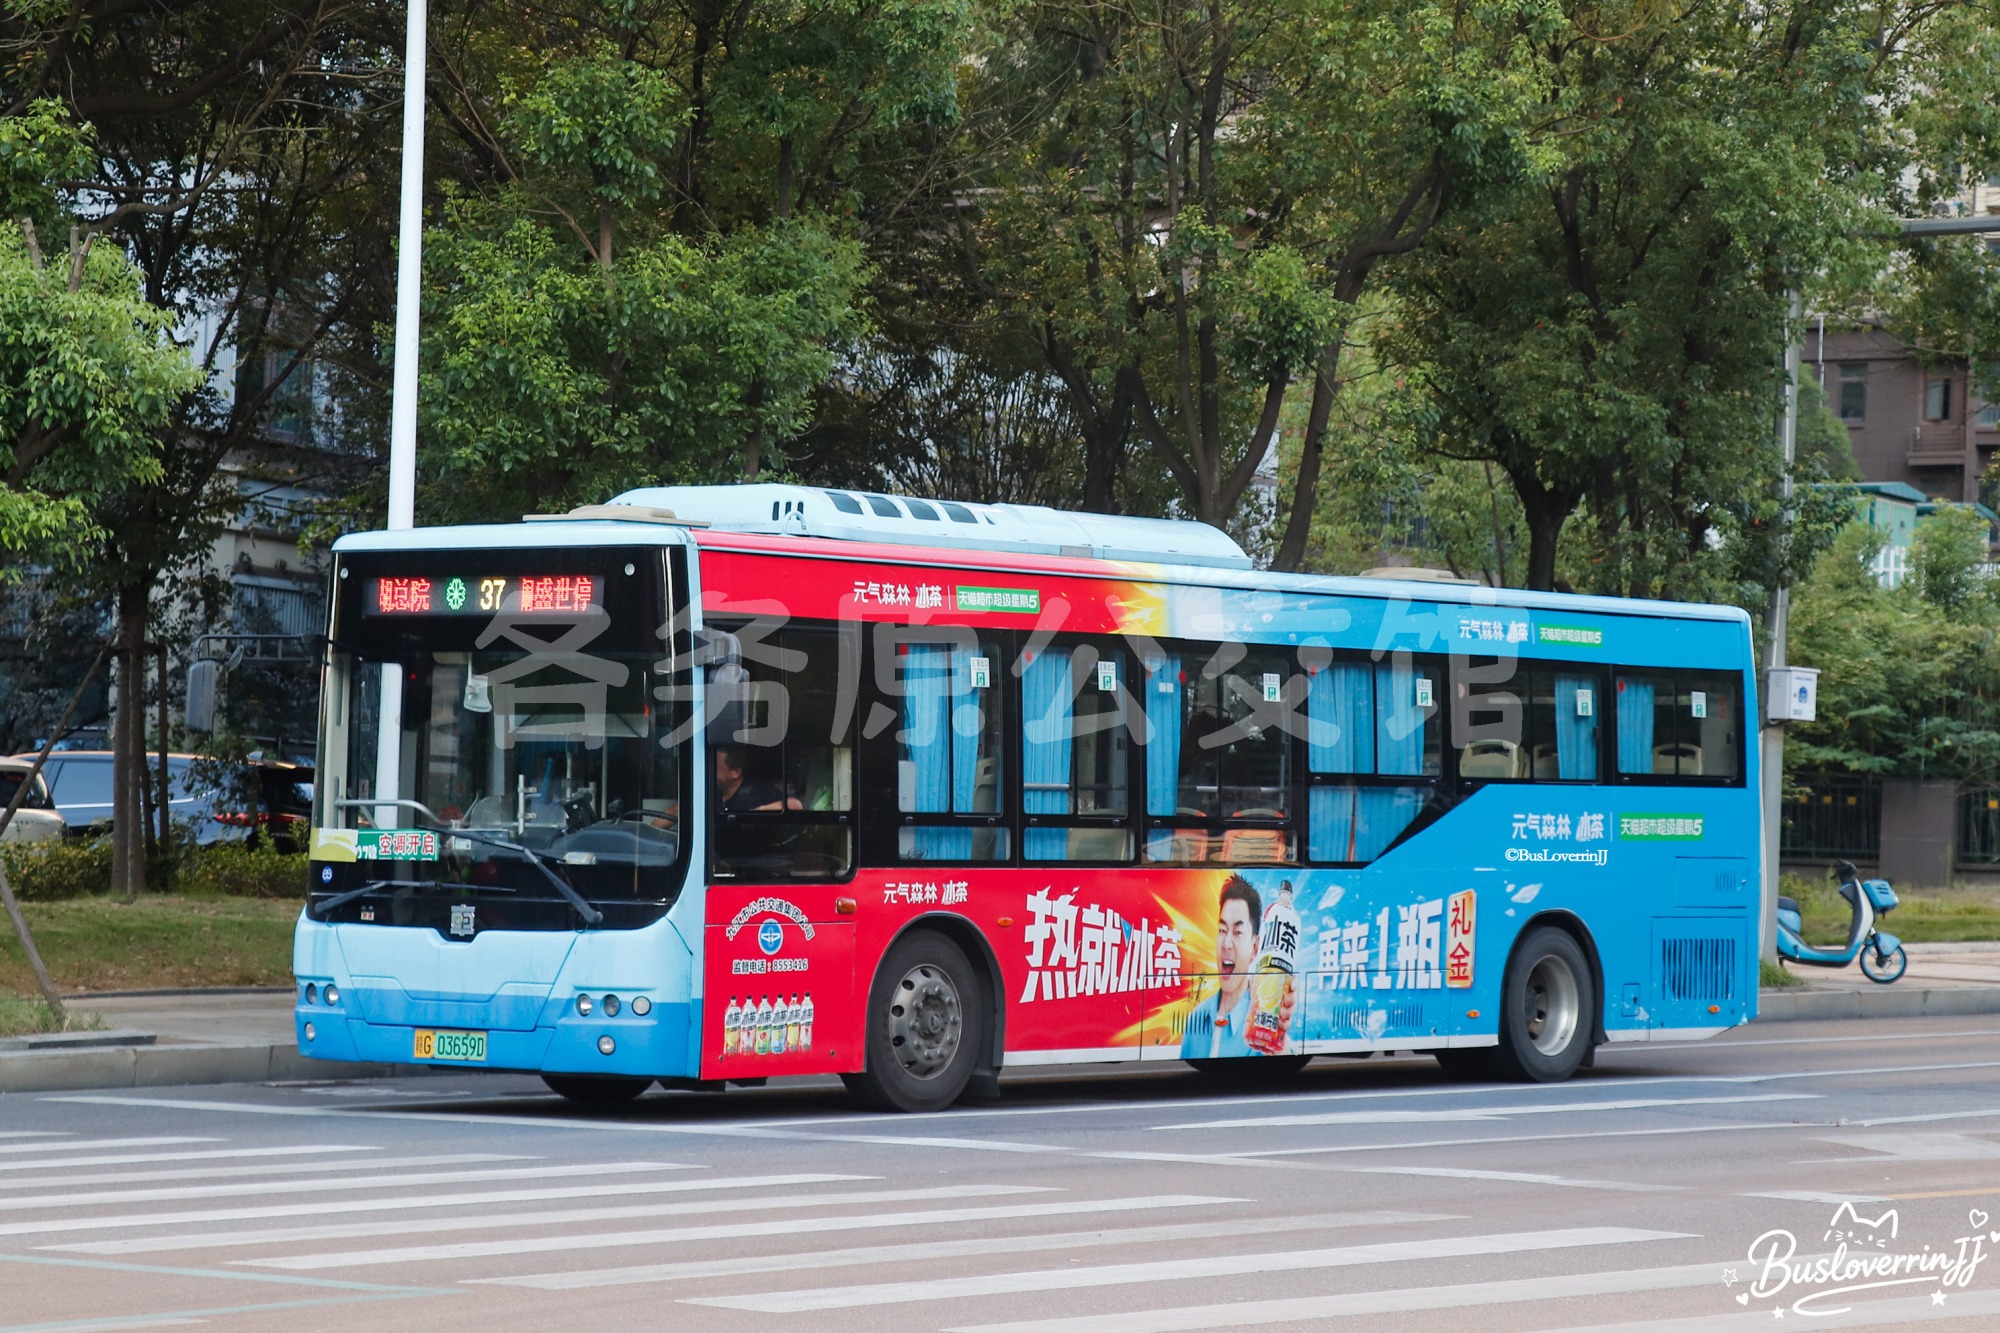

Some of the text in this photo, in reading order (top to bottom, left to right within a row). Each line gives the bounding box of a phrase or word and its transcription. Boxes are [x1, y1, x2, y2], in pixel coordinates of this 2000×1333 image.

[480, 579, 506, 610] 37
[853, 581, 943, 609] 元气森林 冰茶
[958, 590, 1038, 609] 天猫超市超级星期5
[1460, 620, 1504, 640] 元气森林
[1512, 813, 1572, 840] 元气森林
[1620, 818, 1703, 836] 天猫超市超级星期5
[379, 833, 435, 856] 空调开启
[883, 880, 968, 905] 元气森林 冰茶
[726, 897, 815, 941] 九江市公共交通集团公司
[1261, 915, 1299, 959] 冰茶
[1318, 898, 1444, 990] 再来1瓶
[1449, 898, 1472, 981] 礼金
